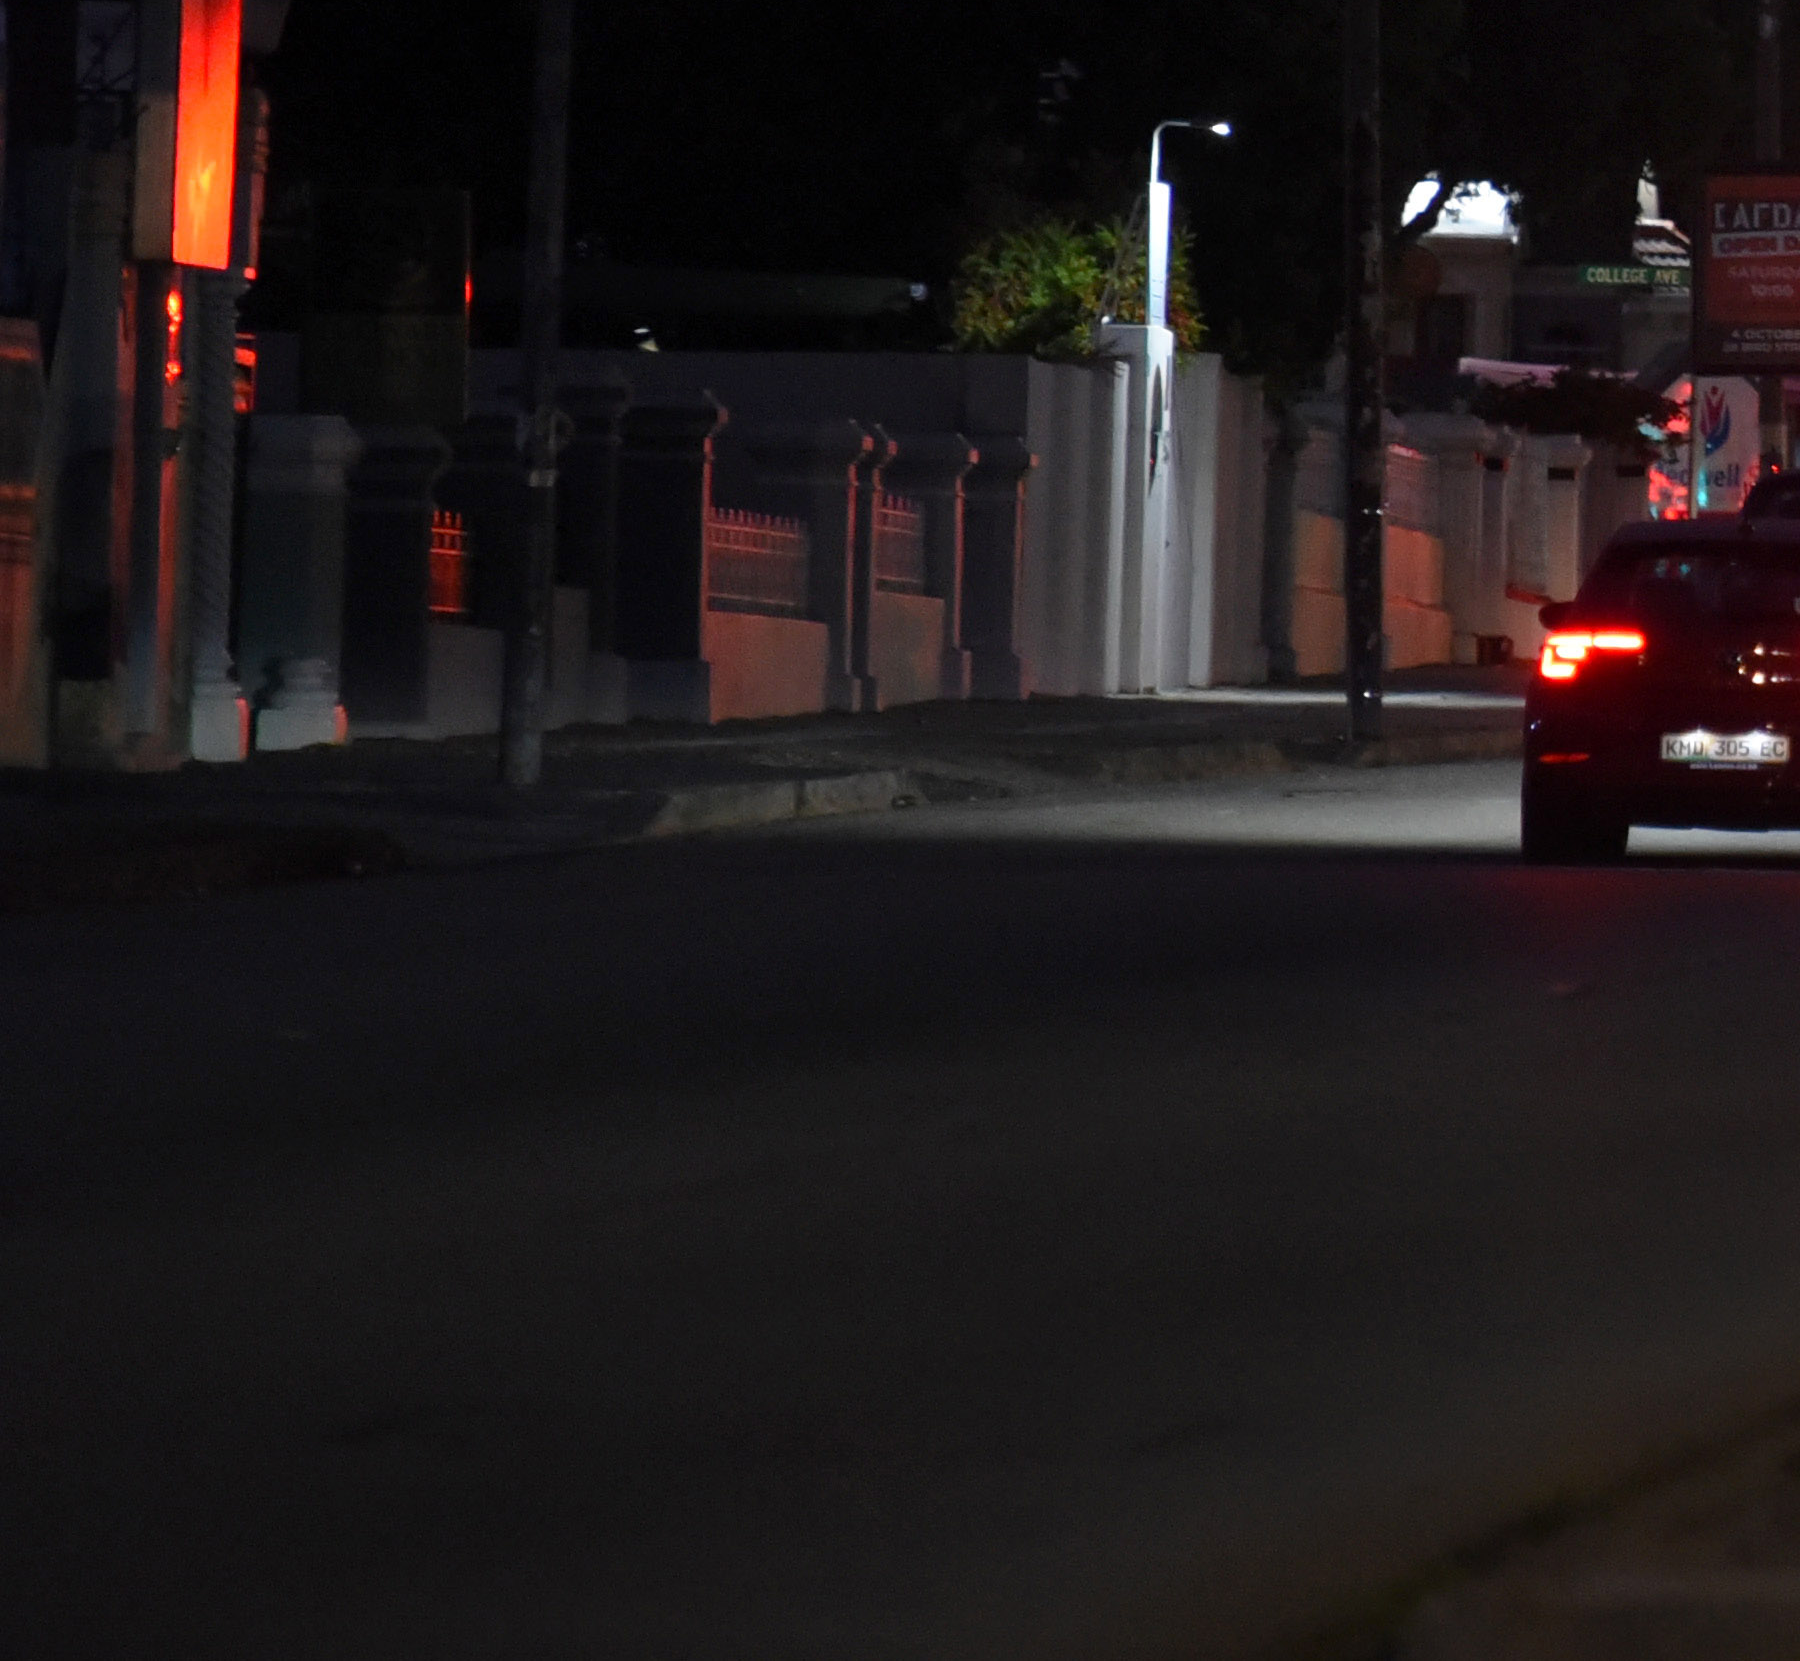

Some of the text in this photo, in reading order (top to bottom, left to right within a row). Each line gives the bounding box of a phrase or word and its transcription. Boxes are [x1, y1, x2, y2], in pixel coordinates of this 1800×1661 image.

[1586, 267, 1681, 285] COLLEGE AVE
[1715, 739, 1750, 757] 305
[1761, 740, 1785, 758] EC
